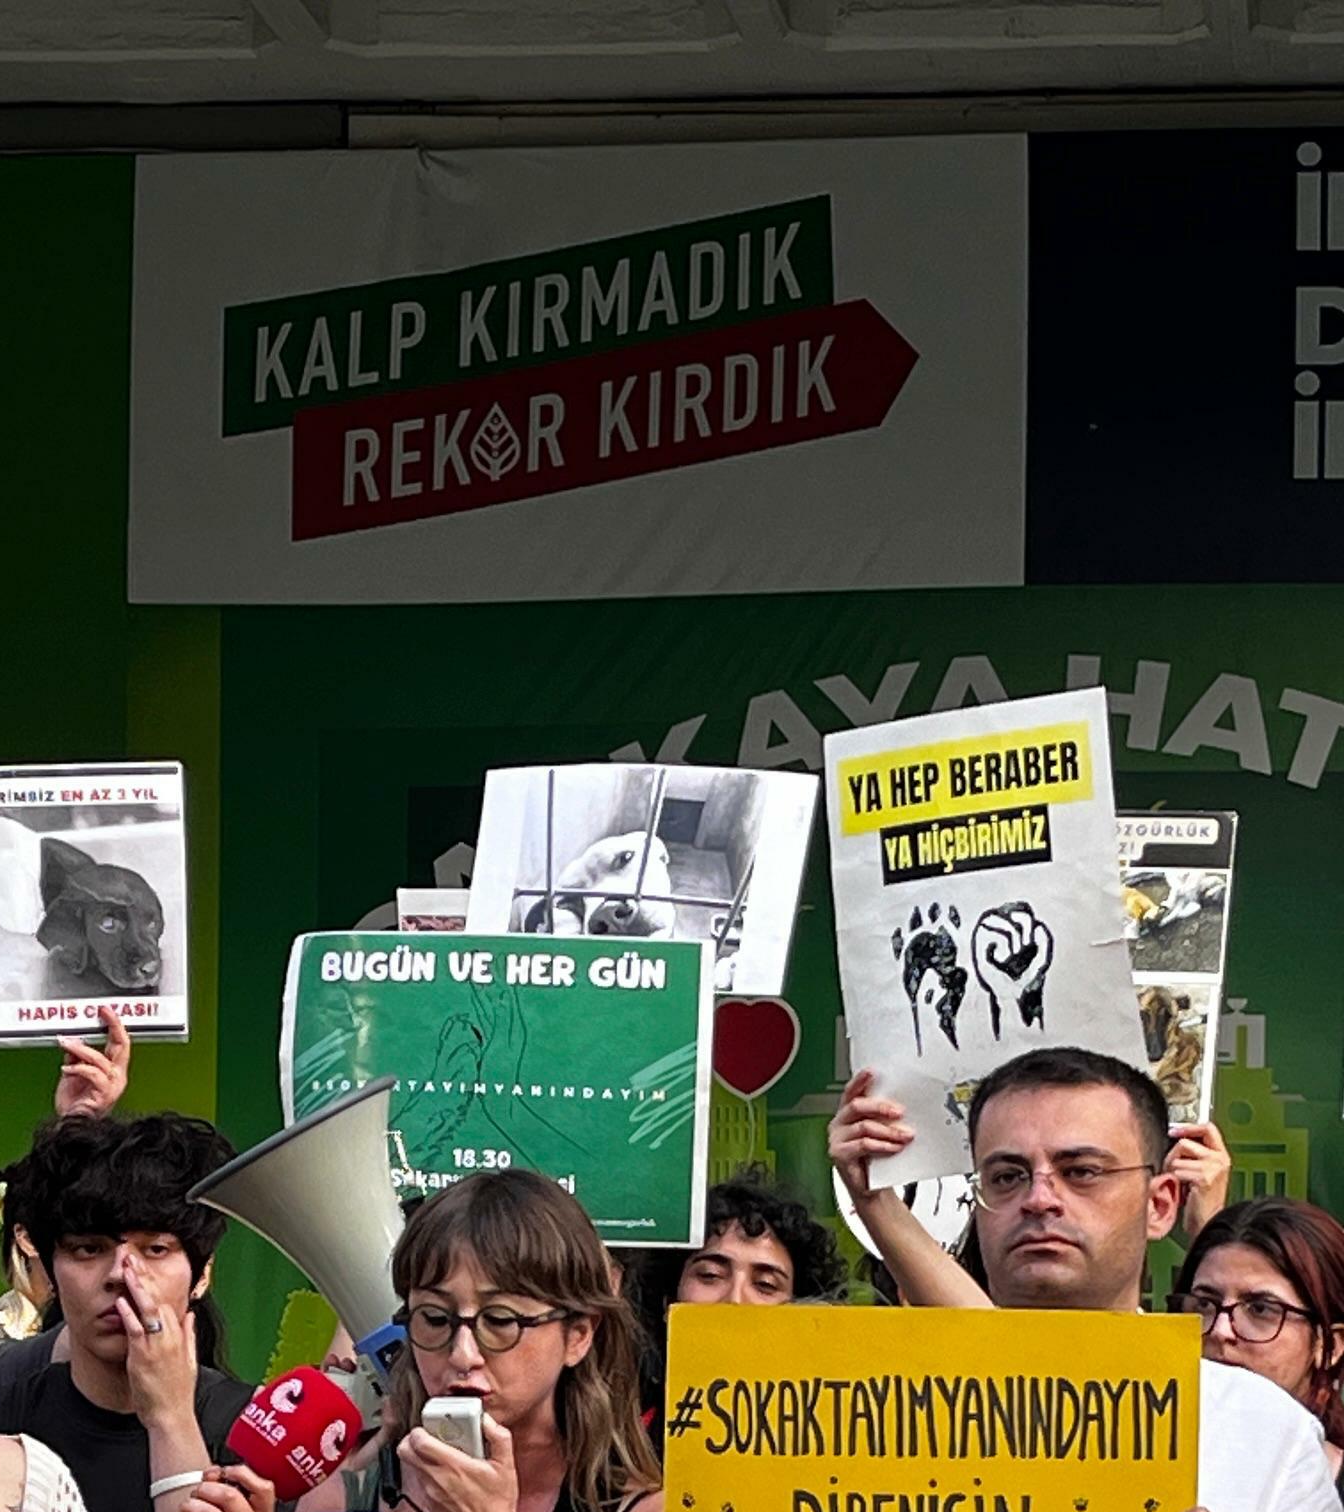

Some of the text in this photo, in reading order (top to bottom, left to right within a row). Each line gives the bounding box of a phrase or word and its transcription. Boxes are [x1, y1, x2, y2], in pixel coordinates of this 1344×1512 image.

[255, 222, 804, 403] KALP KIRMADIK
[598, 335, 837, 460] KIRDIK
[60, 789, 84, 802] EN
[89, 788, 112, 802] AZ
[131, 787, 159, 801] YIL
[847, 740, 1080, 816] YA HEP BERABER
[884, 808, 1048, 875] YA HİÇBİRİMİZ
[320, 945, 667, 989] BUGÜN VE HER GÜN
[18, 1003, 78, 1021] HAPİS
[453, 1148, 511, 1168] 18.30
[242, 1402, 288, 1442] anka
[667, 1374, 1179, 1462] #SOKAKTAYIMYANINDAYIM
